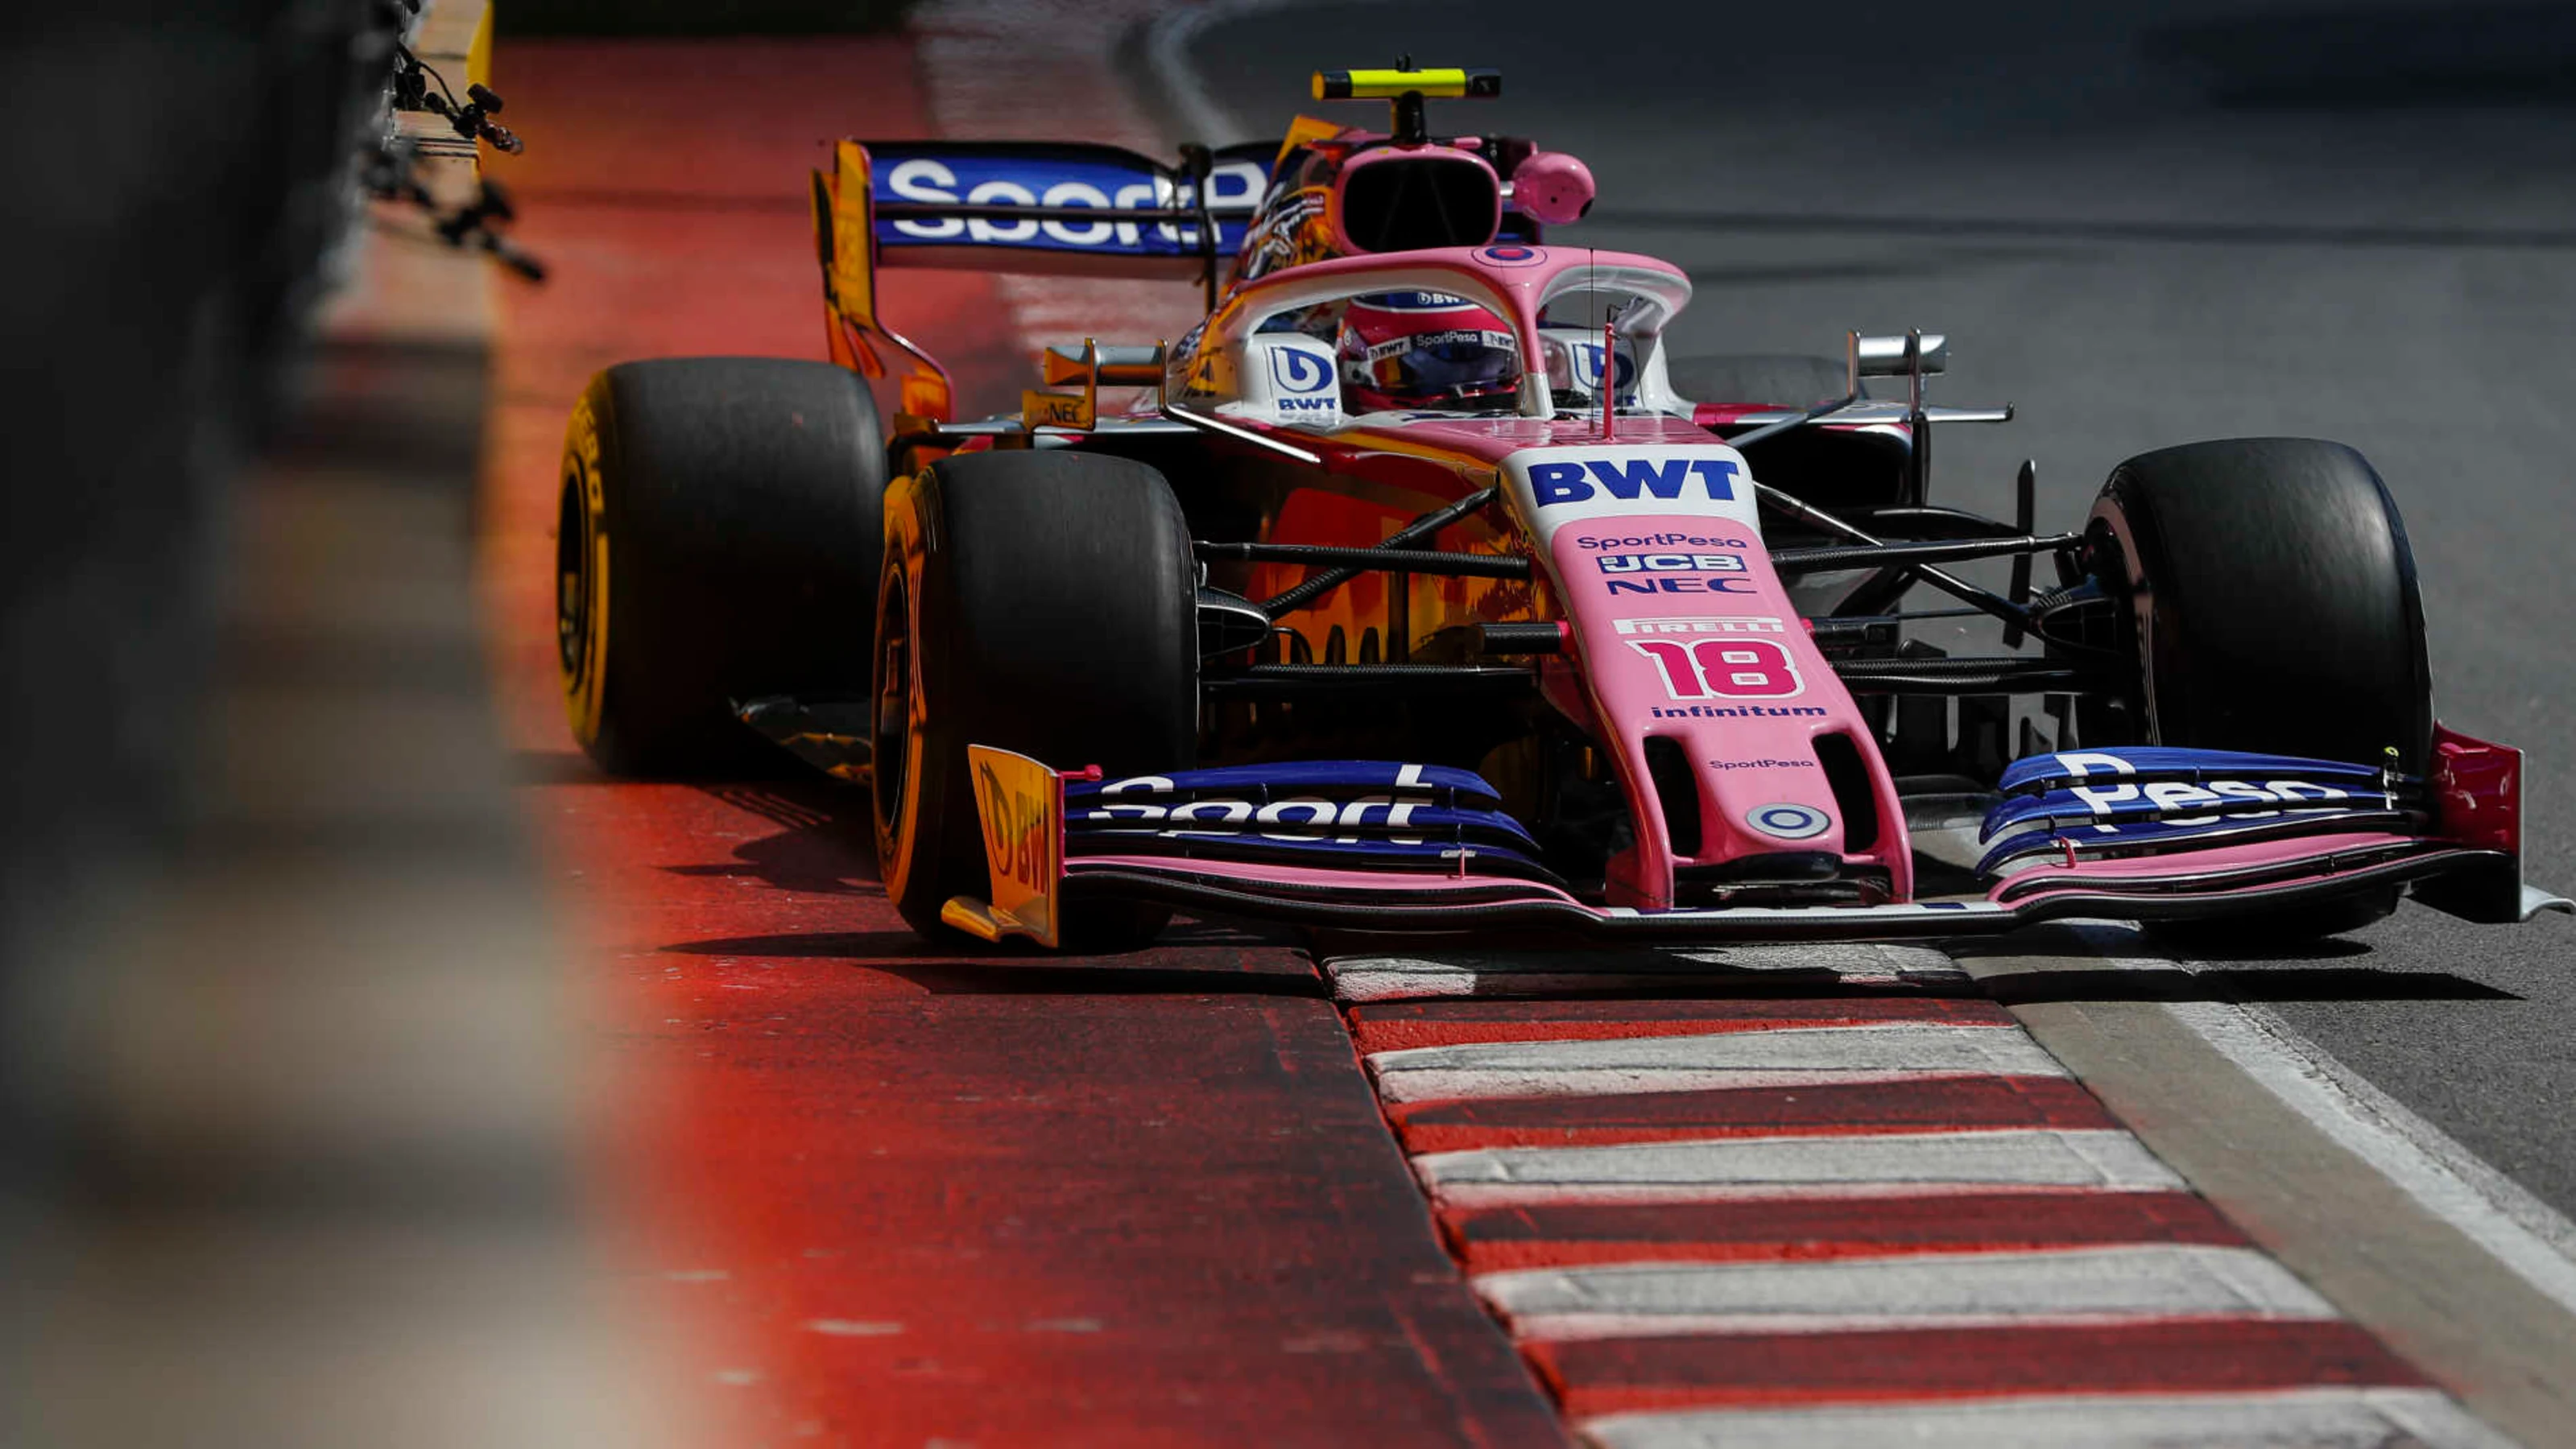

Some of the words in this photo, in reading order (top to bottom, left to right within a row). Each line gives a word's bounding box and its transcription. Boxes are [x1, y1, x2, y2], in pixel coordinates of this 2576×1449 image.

[889, 159, 1269, 246] SportP
[1416, 331, 1478, 348] SportPesa
[1279, 398, 1335, 411] BWT
[1527, 459, 1739, 508] BWT
[1577, 533, 1747, 551] SportPesa
[1599, 554, 1745, 572] JCB
[1606, 578, 1757, 595] NEC
[1612, 617, 1785, 634] PIRELLI
[1625, 638, 1806, 700] 18
[1652, 706, 1827, 718] infinitum
[1710, 759, 1814, 770] SportPesa
[2054, 753, 2351, 832] Pesa
[1089, 764, 1433, 845] Sport
